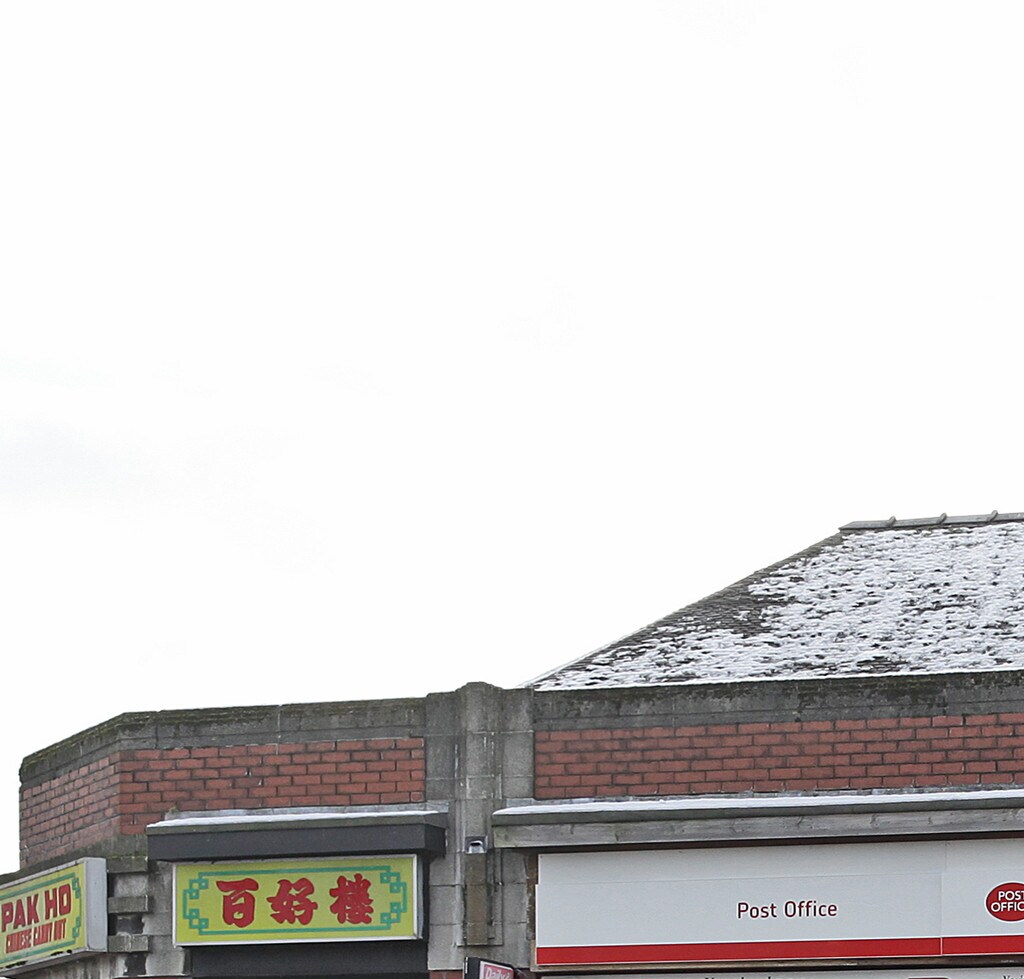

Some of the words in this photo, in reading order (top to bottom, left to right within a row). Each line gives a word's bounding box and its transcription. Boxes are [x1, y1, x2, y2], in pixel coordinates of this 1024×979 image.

[1, 893, 39, 933] PAK
[44, 884, 72, 920] HO
[737, 902, 777, 919] Post
[784, 900, 837, 918] Office
